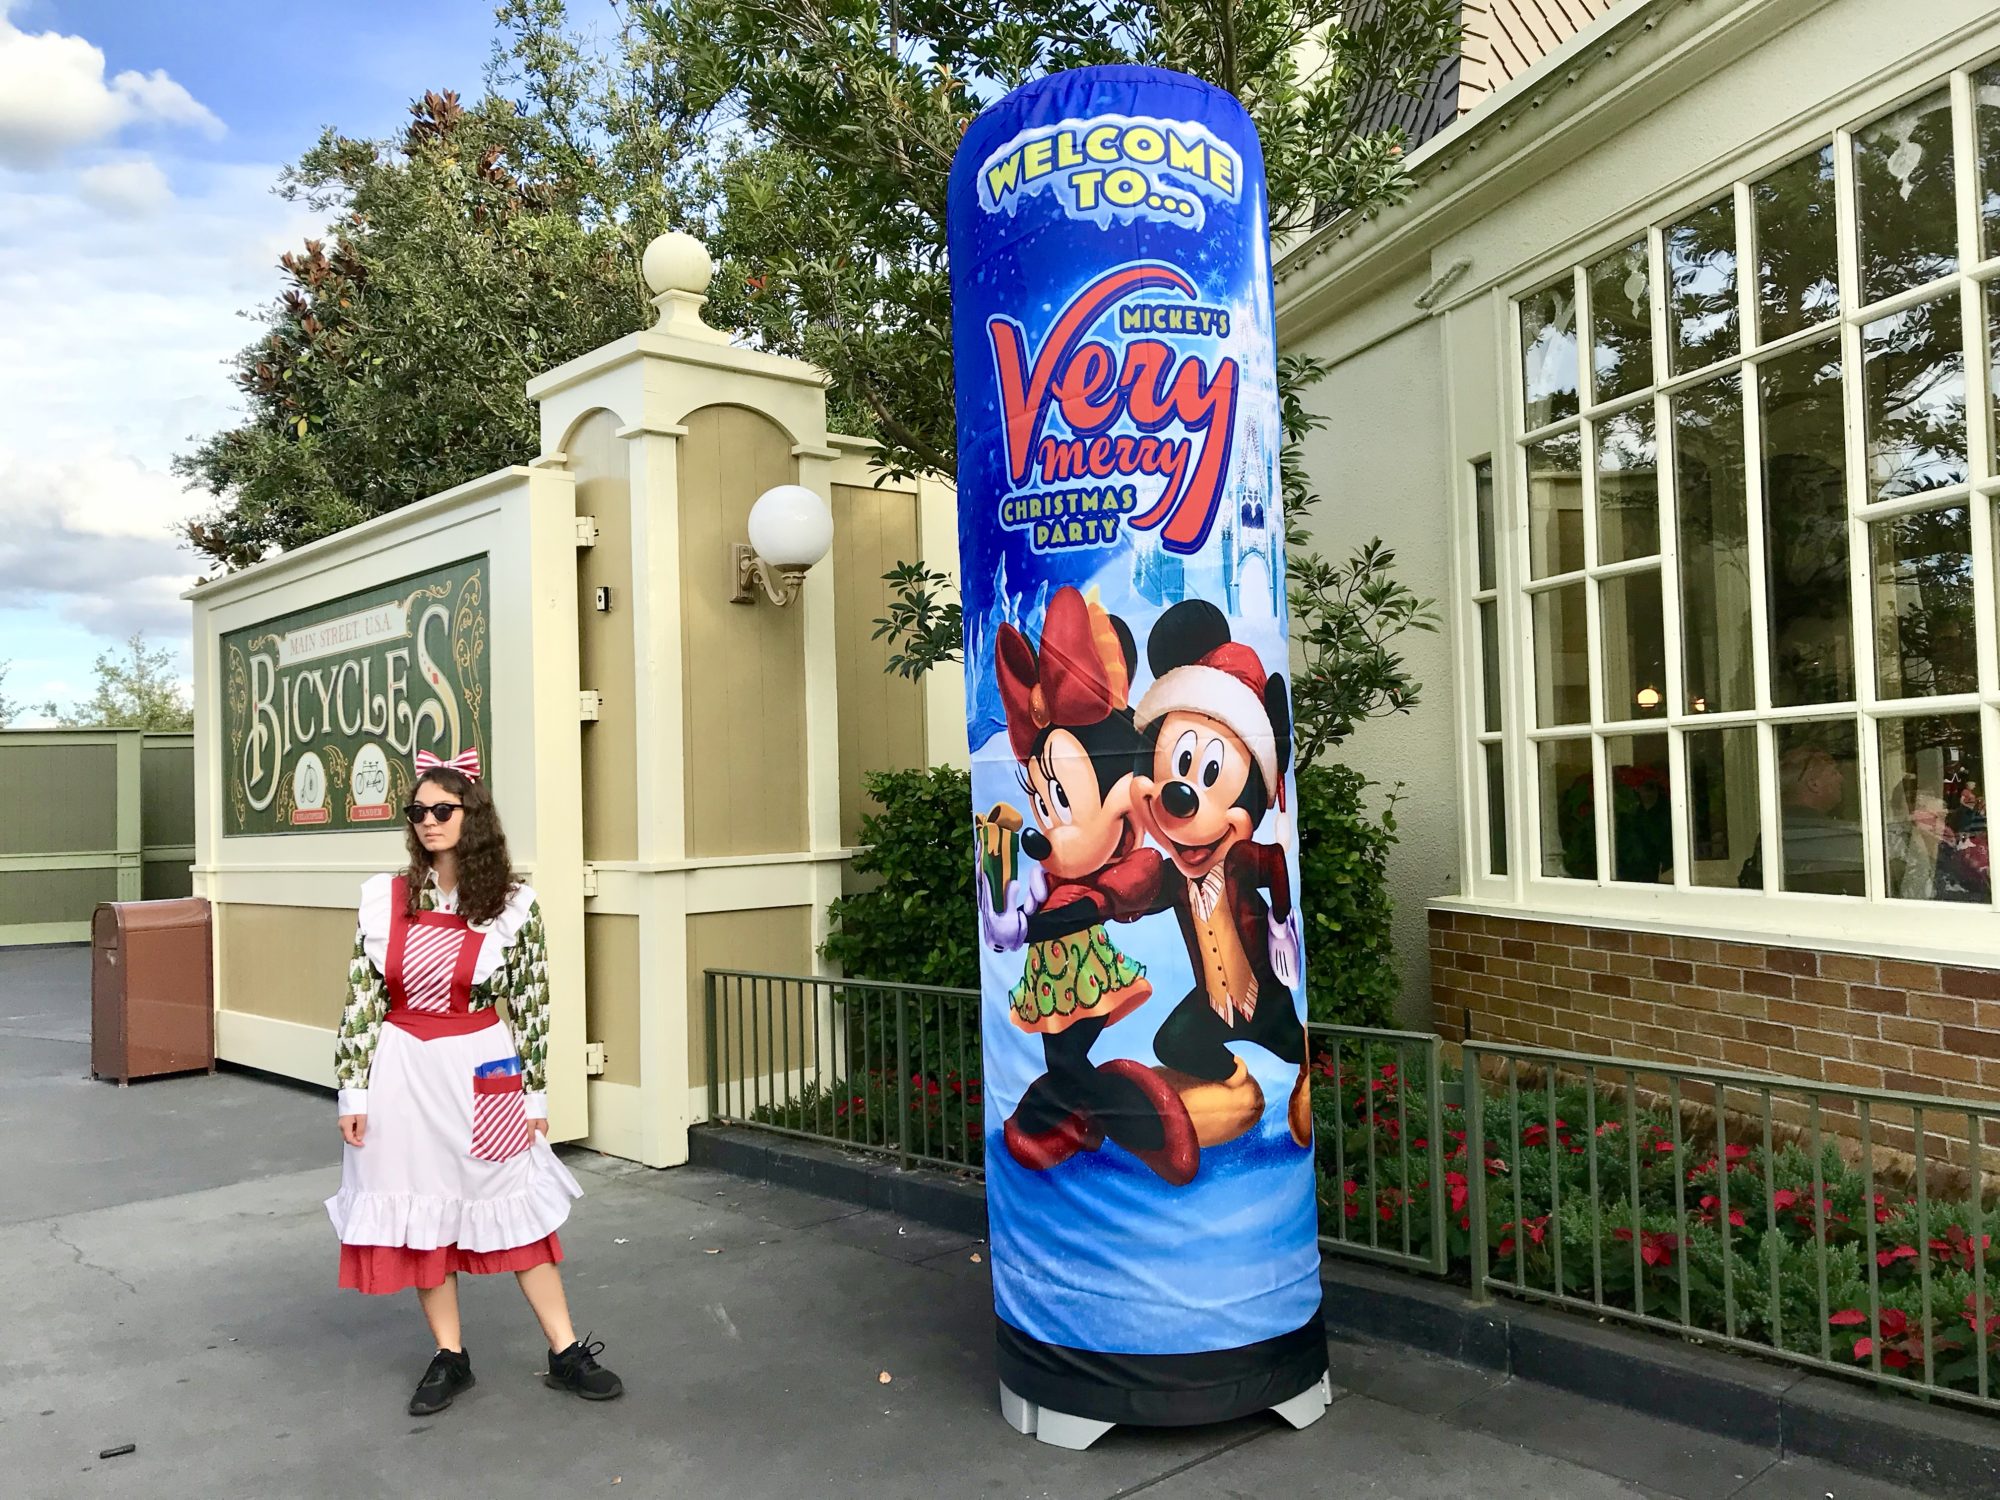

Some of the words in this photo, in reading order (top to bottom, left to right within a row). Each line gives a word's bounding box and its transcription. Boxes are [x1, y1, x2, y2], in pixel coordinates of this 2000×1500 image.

[986, 124, 1235, 206] WELCOME
[1069, 167, 1195, 217] TO...
[1121, 305, 1229, 337] MICKEY'S
[990, 263, 1239, 554] Very
[1002, 485, 1137, 524] CHRISTMAS
[1037, 434, 1192, 529] merry
[1034, 516, 1119, 548] PARTY
[290, 632, 316, 656] MAIN
[243, 603, 461, 811] BICYCLES
